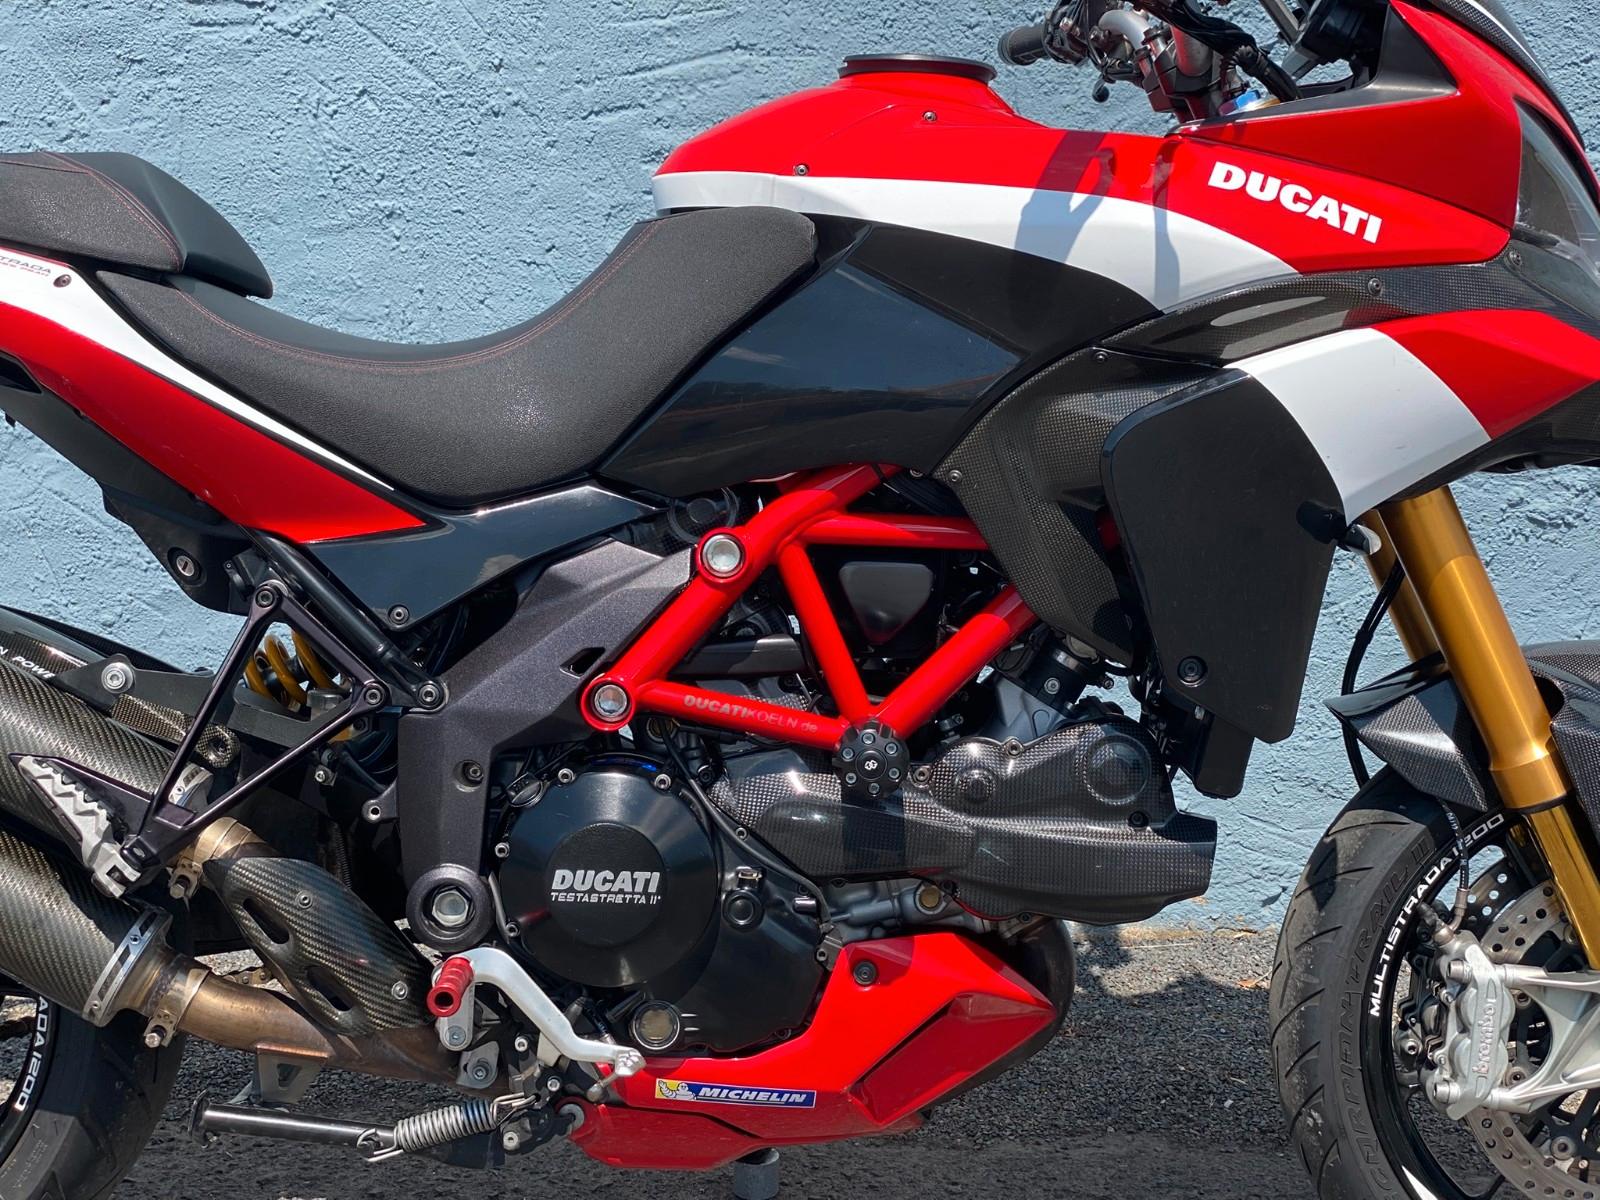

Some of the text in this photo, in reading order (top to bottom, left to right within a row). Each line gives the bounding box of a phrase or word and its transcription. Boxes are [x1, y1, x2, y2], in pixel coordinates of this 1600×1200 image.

[1208, 161, 1382, 244] DUCATI
[550, 892, 646, 904] TESTASTRETTA
[551, 869, 661, 893] DUCATI
[1369, 813, 1505, 1018] MULTISTRADA 1200
[1472, 1003, 1496, 1075] brembo
[14, 1051, 42, 1112] 1200
[698, 1086, 807, 1104] MICHELIN
